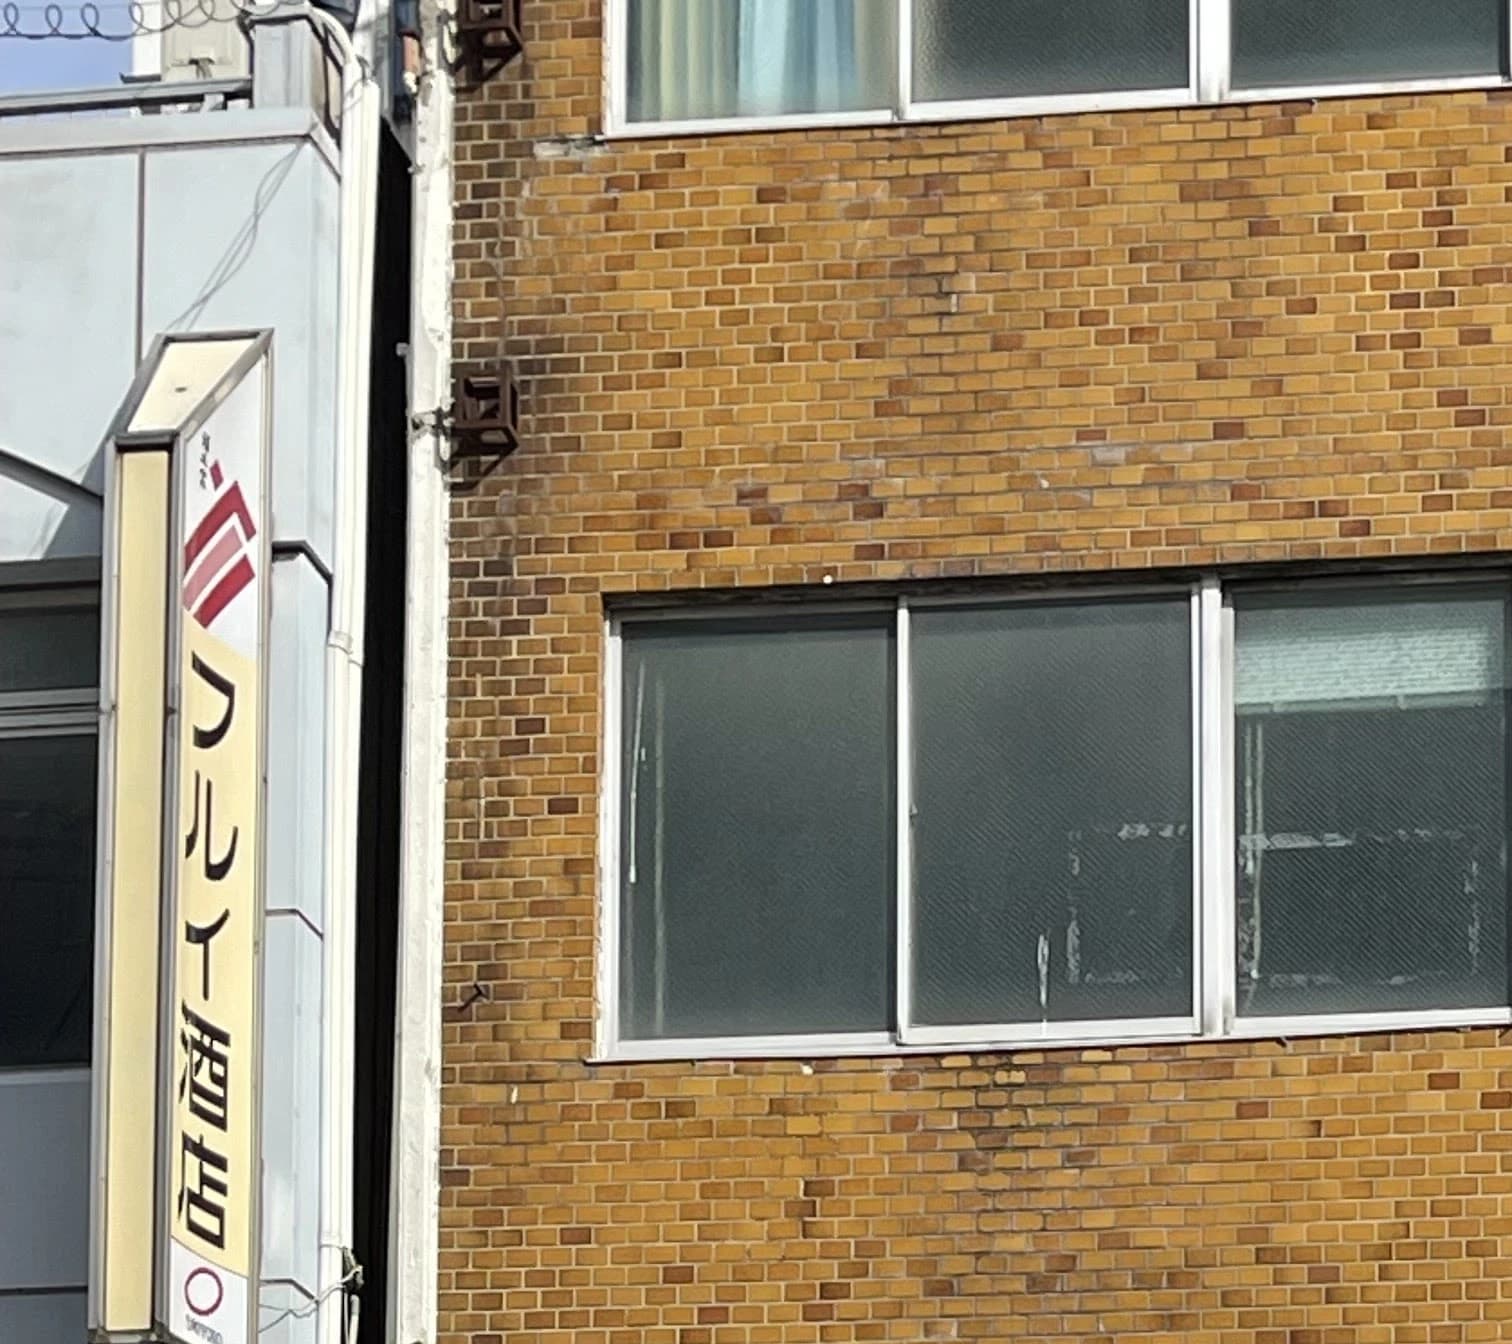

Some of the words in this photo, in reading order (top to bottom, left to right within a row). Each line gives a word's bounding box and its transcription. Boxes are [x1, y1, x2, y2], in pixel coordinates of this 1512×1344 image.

[178, 650, 239, 1250] フルイ酒店
